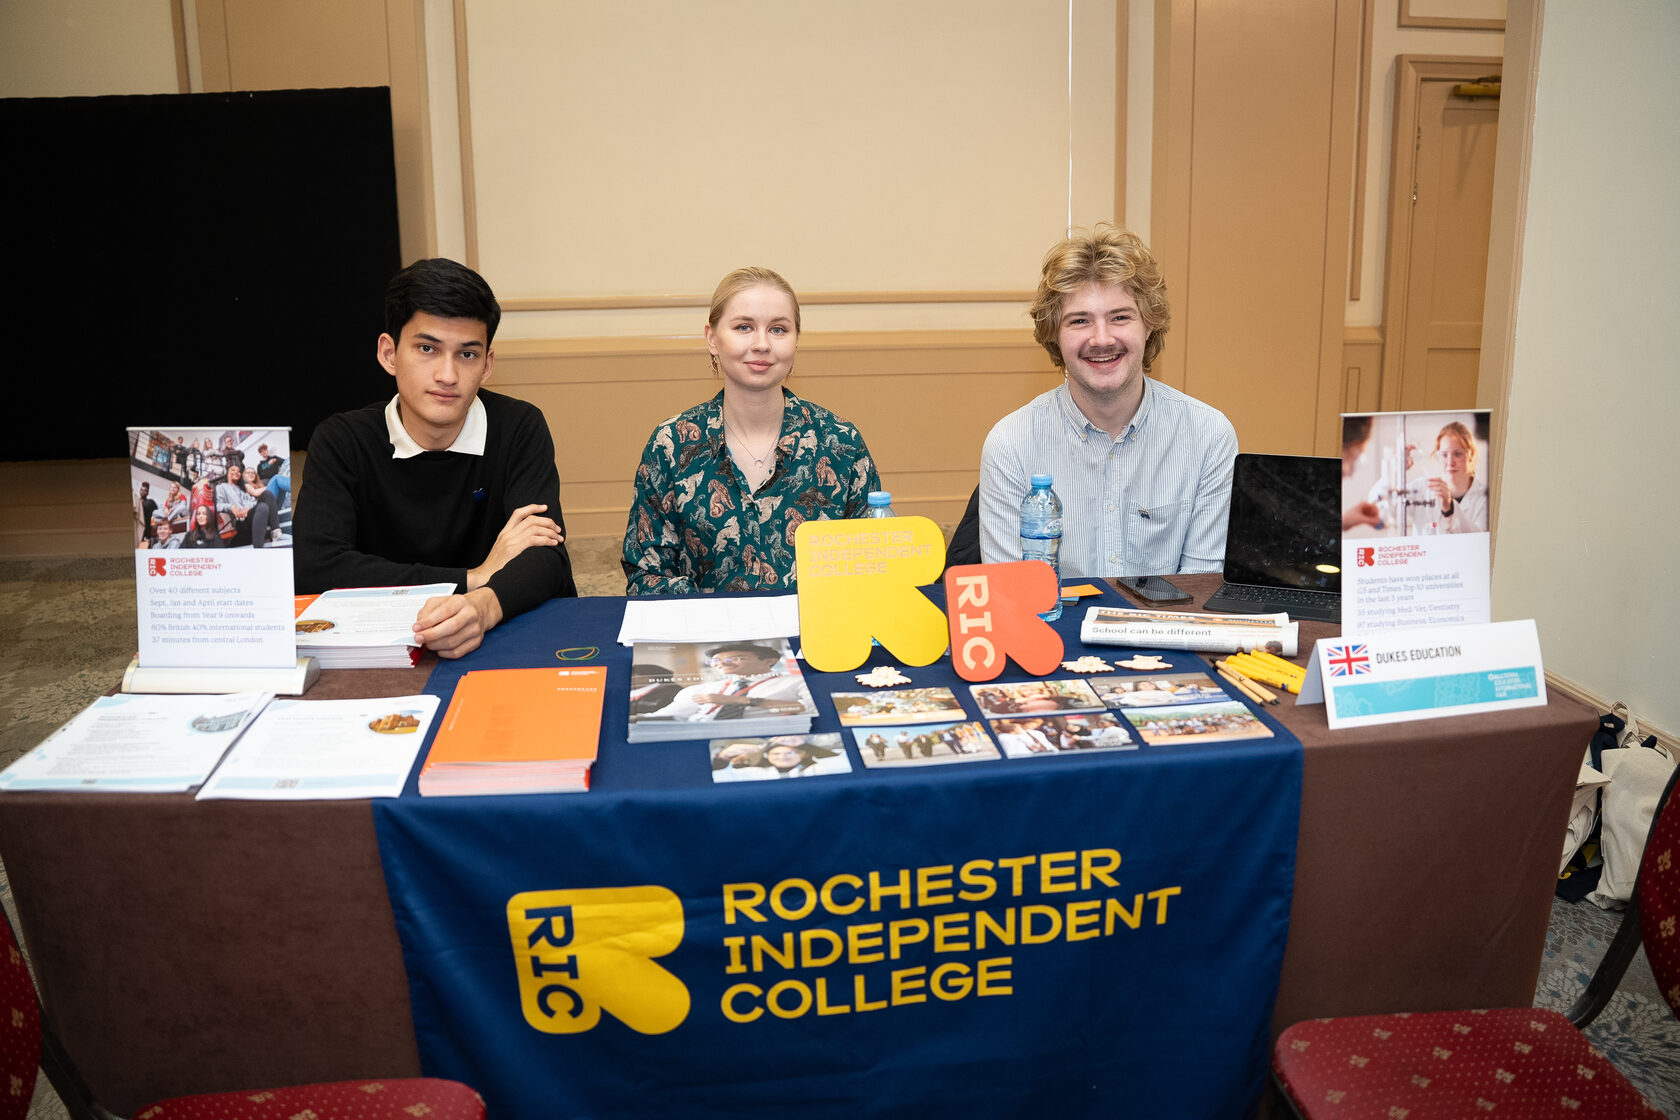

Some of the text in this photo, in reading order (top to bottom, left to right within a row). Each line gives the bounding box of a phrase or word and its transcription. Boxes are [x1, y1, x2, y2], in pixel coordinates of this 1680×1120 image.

[809, 530, 914, 547] ROCHESTER
[810, 544, 933, 562] INDEPENDENT
[1378, 544, 1420, 552] ROCHESTER
[1378, 550, 1427, 559] INDEPENDENT
[1377, 558, 1408, 566] COLLEGE
[809, 561, 888, 577] COLLEGE
[1357, 576, 1387, 585] Students
[1388, 575, 1404, 583] have
[1421, 573, 1442, 583] places
[1451, 571, 1460, 579] all
[149, 587, 166, 595] Over
[180, 586, 209, 594] different
[211, 587, 241, 596] subjects
[1382, 584, 1401, 593] Times
[1402, 583, 1415, 593] Top
[1425, 581, 1464, 590] universities
[150, 600, 168, 608] Sept,
[182, 599, 196, 607] and
[198, 599, 214, 608] April
[234, 599, 254, 607] dates
[1357, 596, 1364, 604] in
[1365, 595, 1376, 603] the
[1378, 594, 1390, 602] last
[1397, 593, 1414, 602] years
[151, 611, 181, 620] Boarding
[1367, 606, 1395, 616] studying
[956, 575, 995, 670] RIC
[1367, 618, 1395, 628] studying
[1167, 628, 1212, 637] different
[192, 635, 209, 643] from
[236, 635, 263, 643] London
[1376, 646, 1462, 664] DUKES EDUCATION
[723, 849, 1121, 924] ROCHESTER
[724, 887, 1181, 973] INDEPENDENT
[525, 906, 584, 1018] RIC
[722, 957, 1012, 1022] COLLEGE
